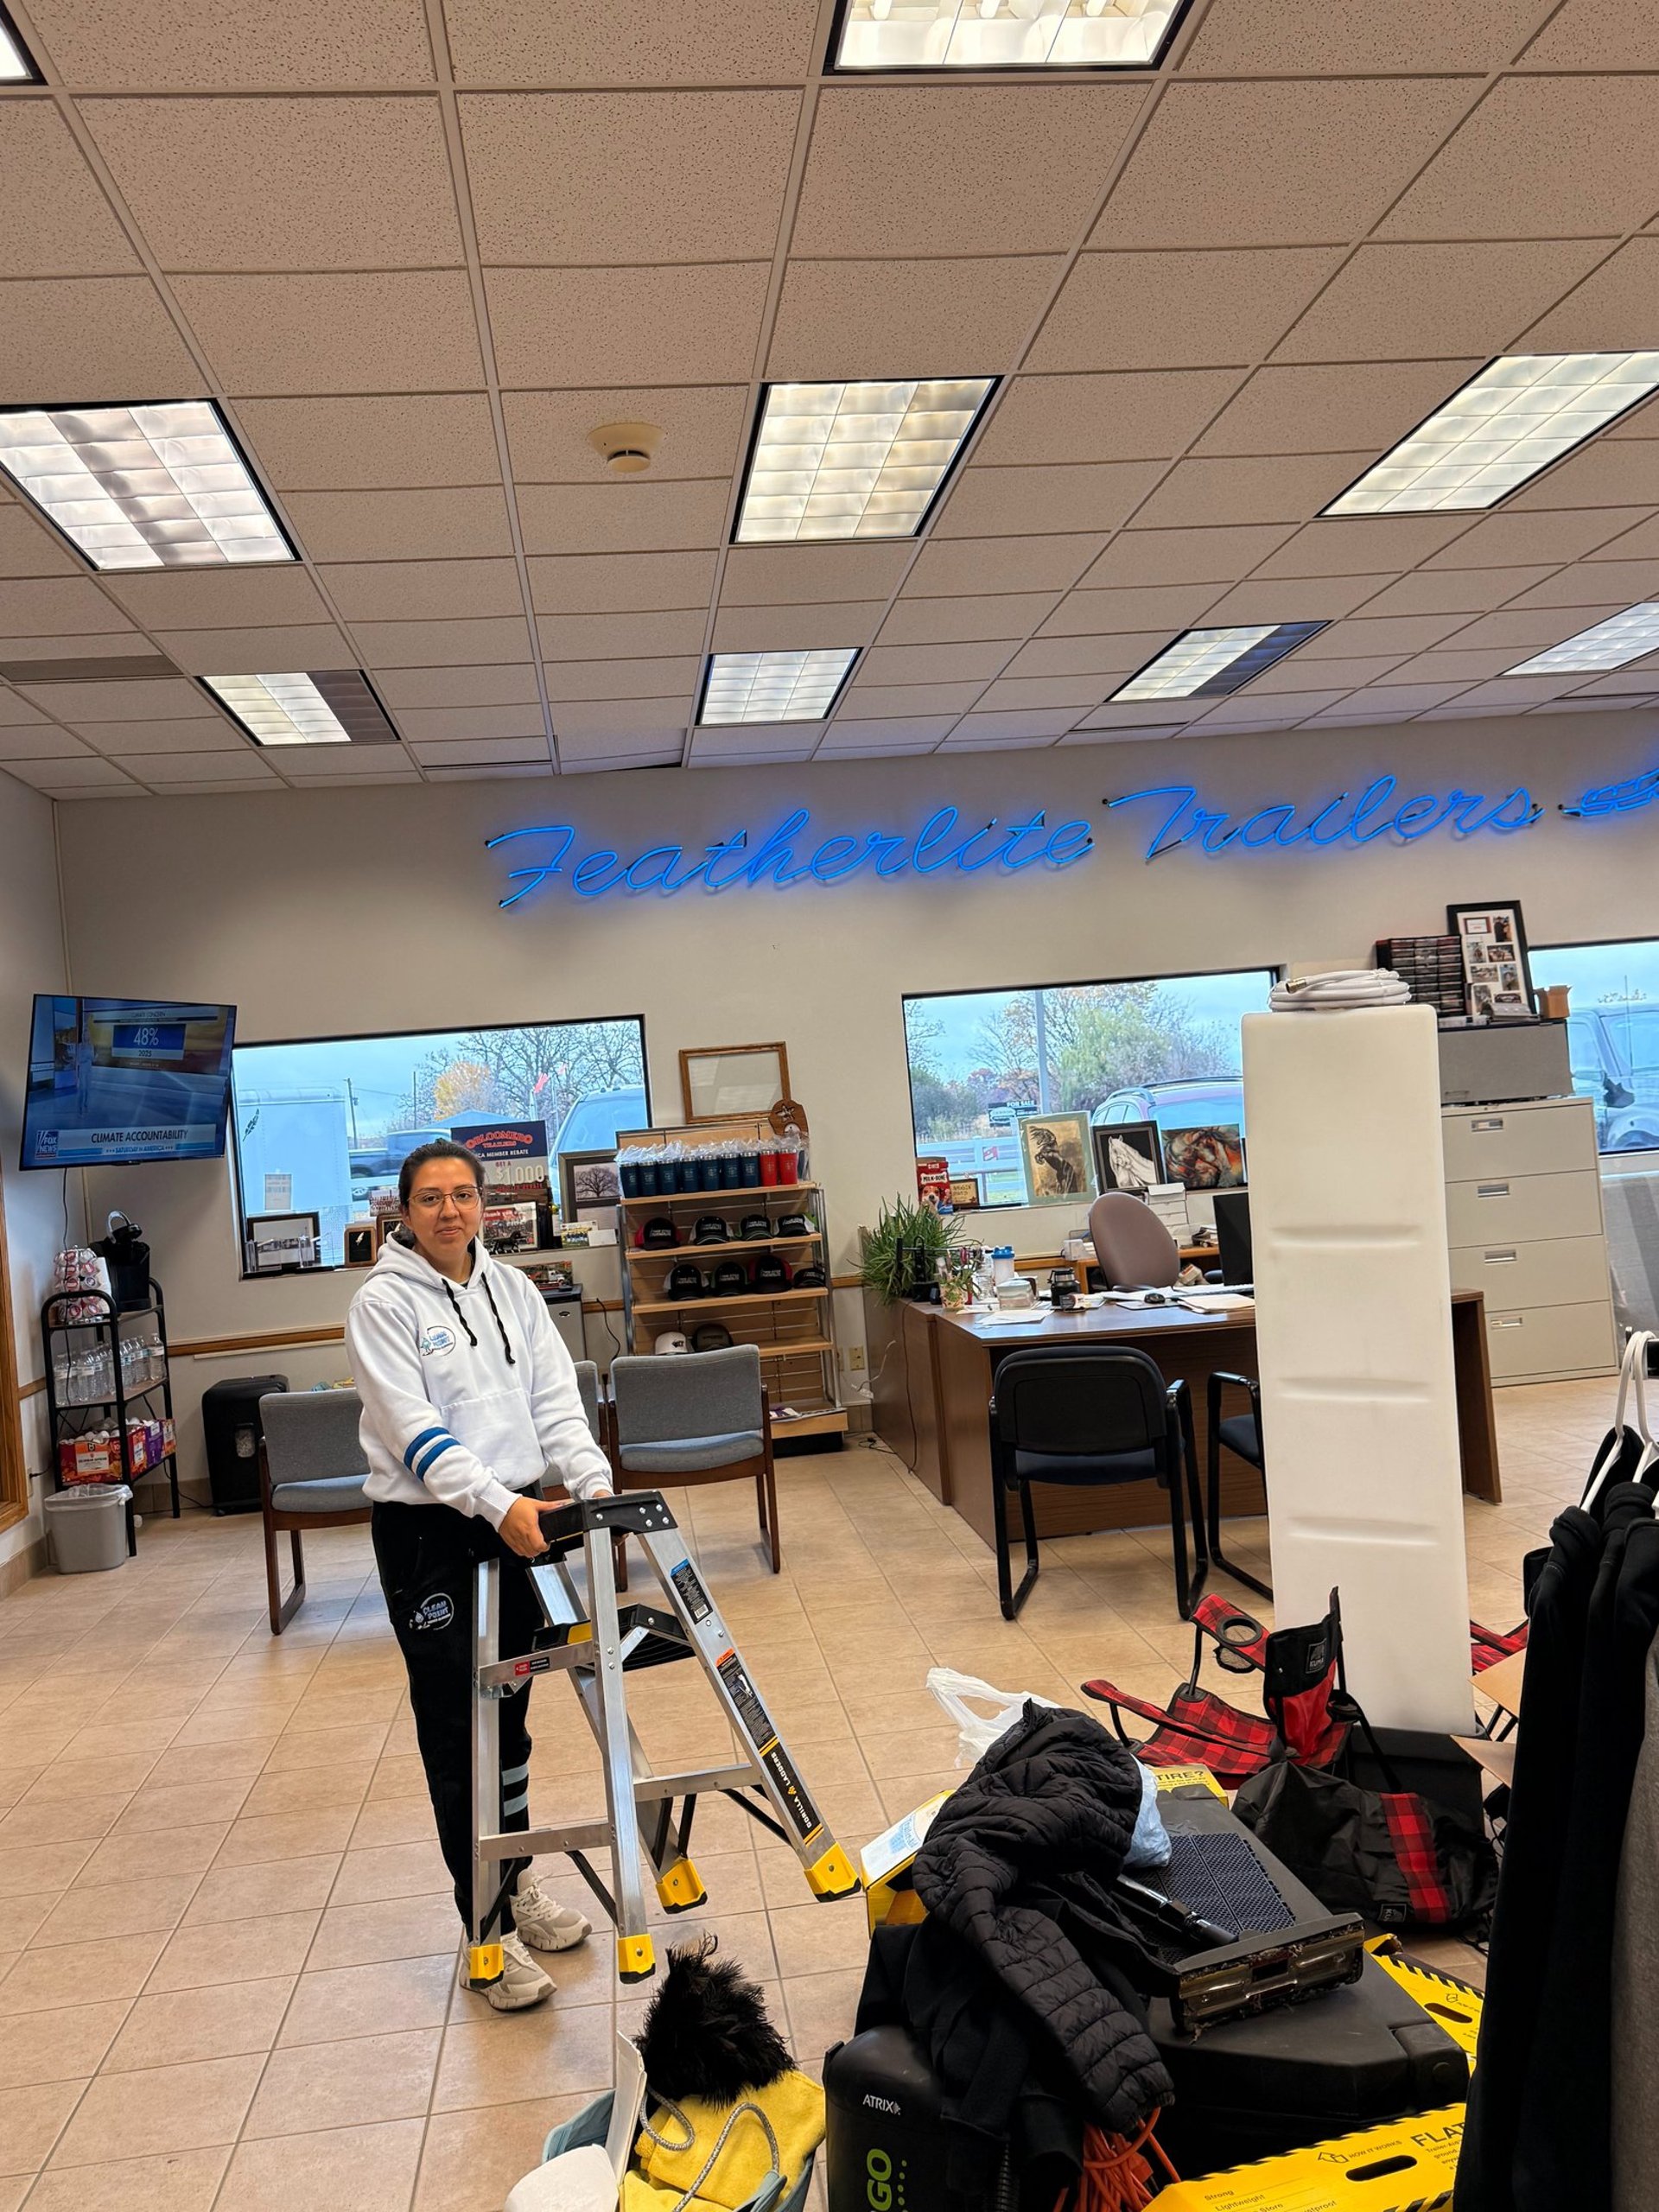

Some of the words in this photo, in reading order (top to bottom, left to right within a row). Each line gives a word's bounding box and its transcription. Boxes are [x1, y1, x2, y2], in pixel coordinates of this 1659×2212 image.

[485, 805, 1095, 908] Featherlite
[1103, 775, 1546, 861] Trailers
[133, 1027, 159, 1046] 48%
[44, 1136, 57, 1145] FOX
[91, 1132, 124, 1144] CLIMATE
[124, 1129, 188, 1141] ACCOUNTABILITY
[39, 1145, 57, 1154] NEWS
[496, 1165, 544, 1186] $1,000
[423, 1600, 447, 1615] CLEAN
[771, 1752, 791, 1787] LADDERS
[794, 1796, 812, 1829] GORILLA
[862, 2094, 893, 2114] ATRIX
[1374, 2139, 1402, 2151] WORKS
[1205, 2190, 1235, 2201] Strong
[1215, 2194, 1265, 2212] Lightweight
